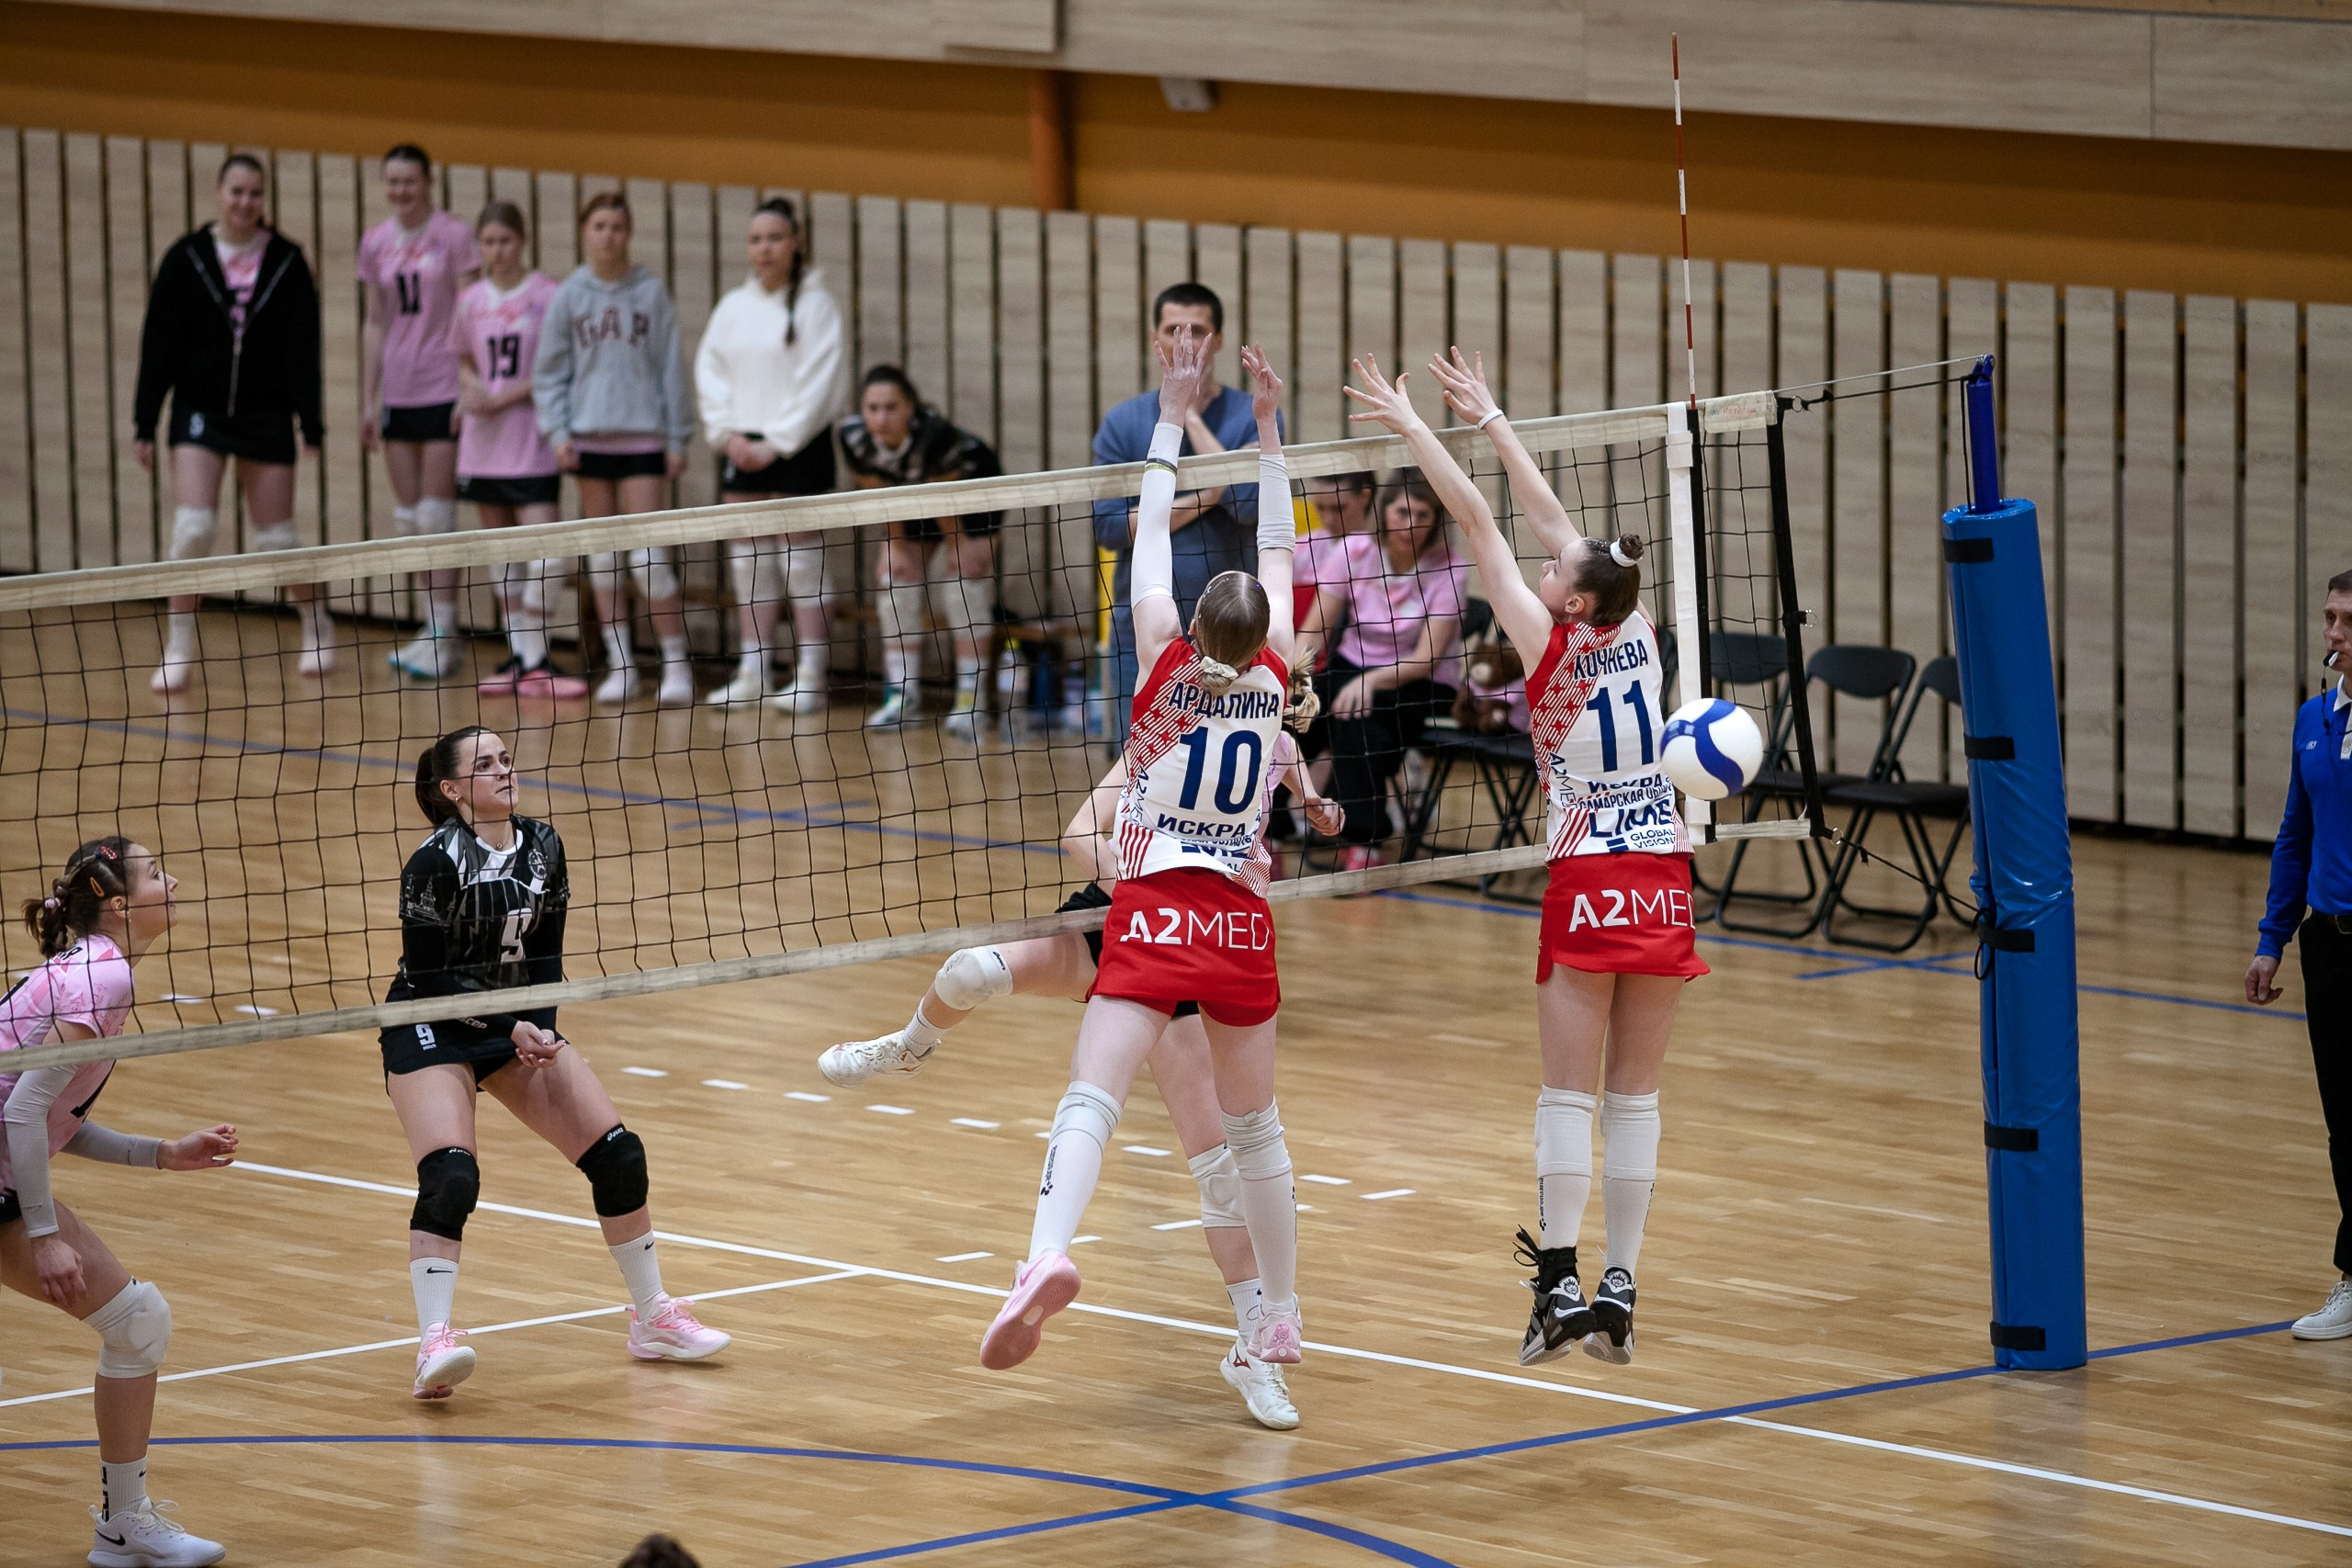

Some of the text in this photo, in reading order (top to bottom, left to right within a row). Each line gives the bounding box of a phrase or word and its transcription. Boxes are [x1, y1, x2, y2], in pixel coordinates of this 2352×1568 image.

[397, 273, 420, 315] 11
[573, 306, 650, 348] GAP
[487, 333, 520, 380] 19
[1574, 638, 1648, 680] КОЧНЕВА
[1168, 681, 1280, 719] АРДАЛИНА
[1586, 680, 1654, 773] 11
[1179, 726, 1262, 815] 10
[1157, 813, 1246, 838] ИСКРА
[1589, 798, 1675, 838] LIME
[1630, 829, 1676, 841] GLOBAL
[1634, 837, 1675, 849] VISION
[1119, 908, 1270, 951] A2MED
[415, 1023, 435, 1045] 9
